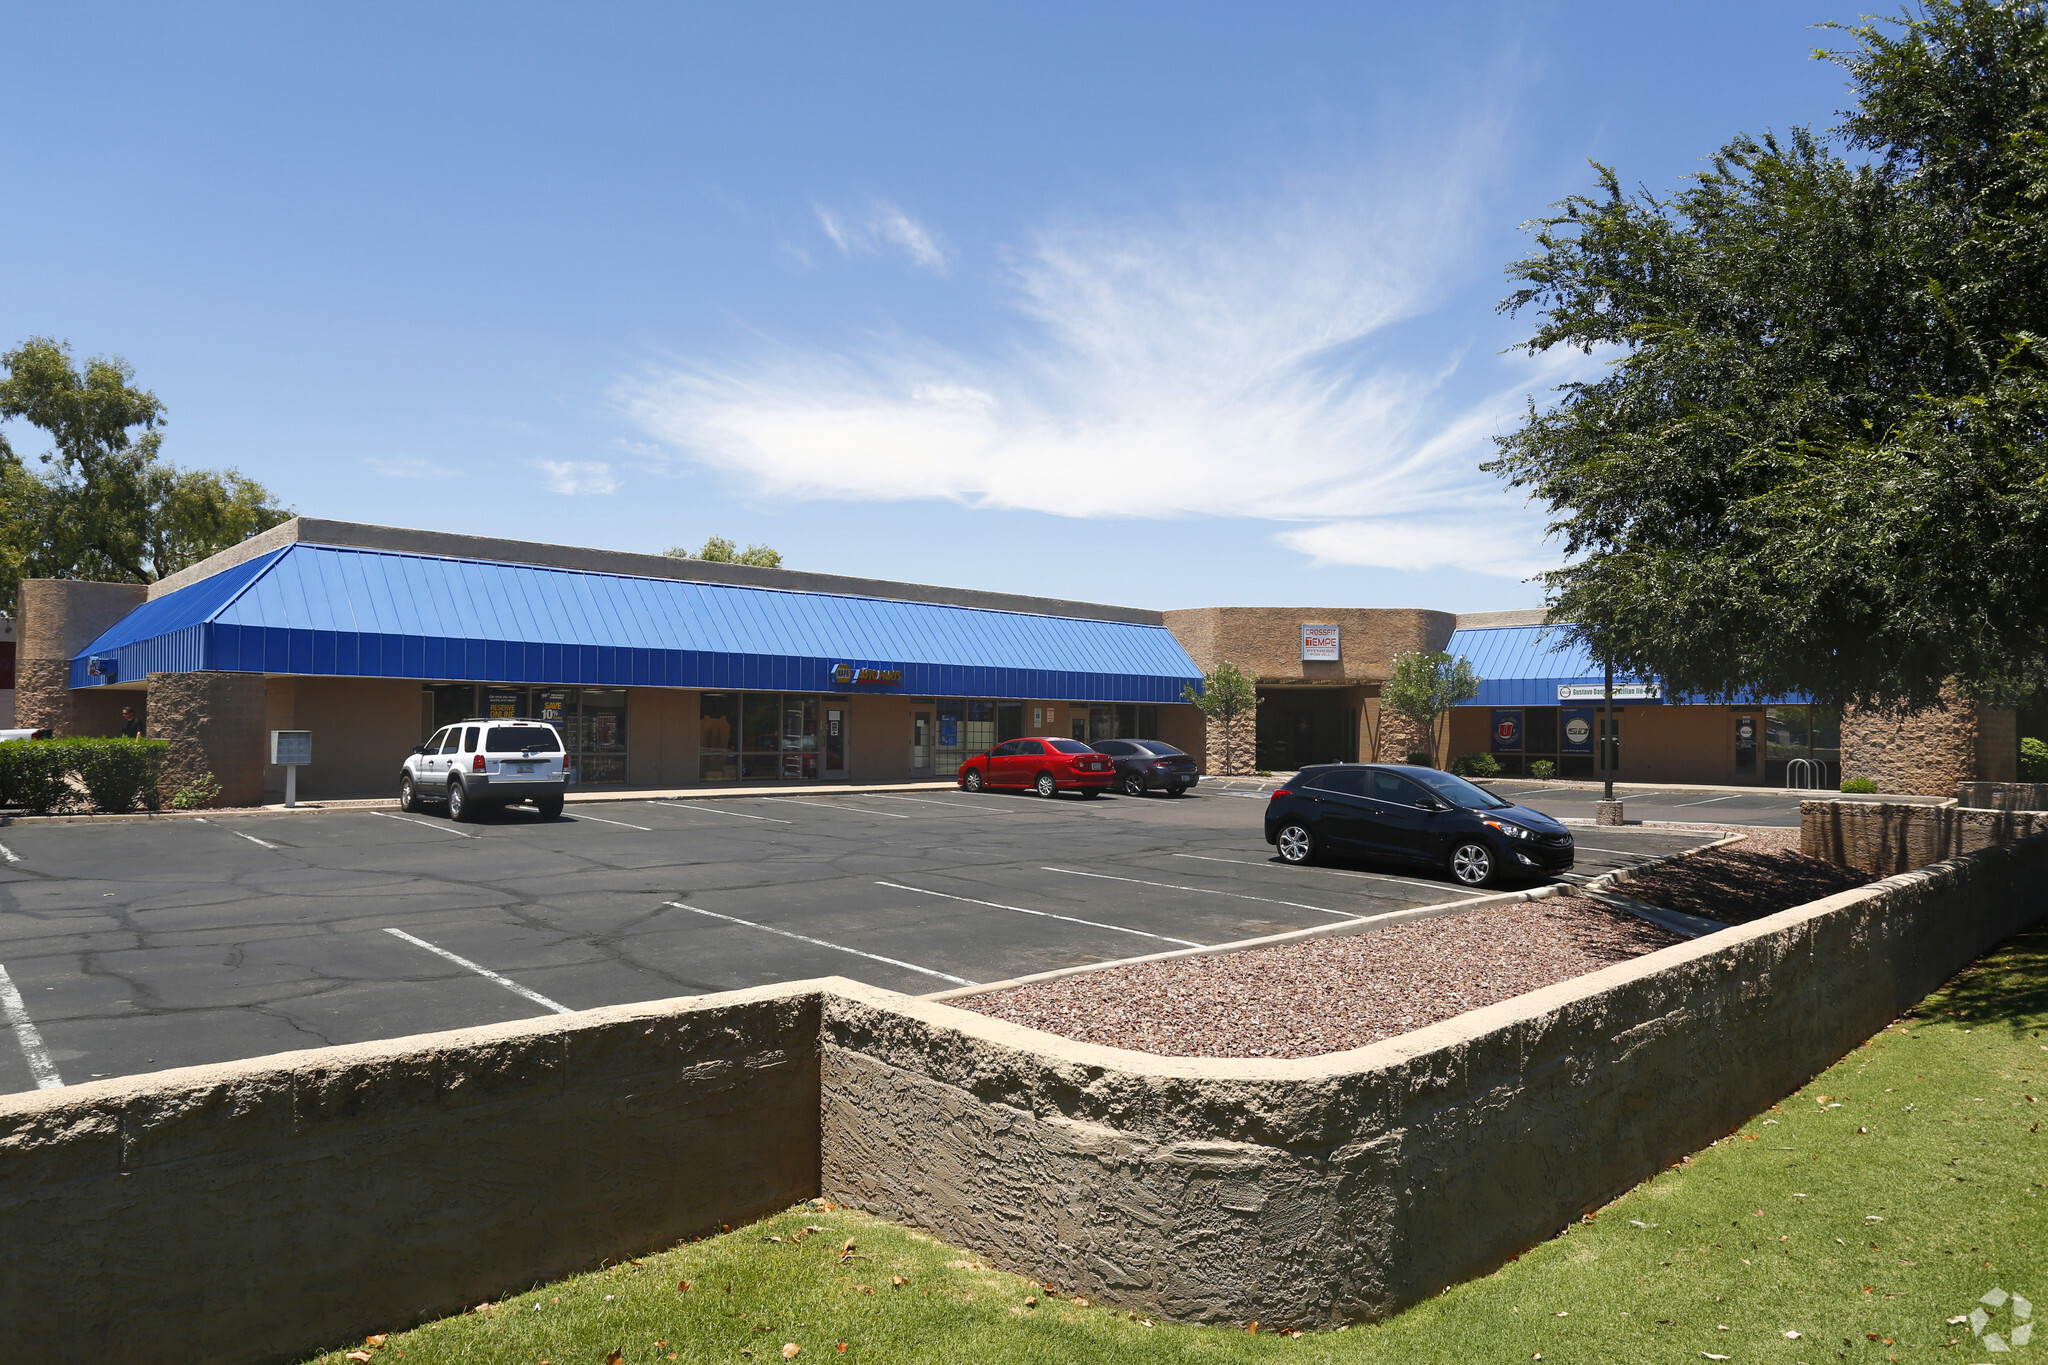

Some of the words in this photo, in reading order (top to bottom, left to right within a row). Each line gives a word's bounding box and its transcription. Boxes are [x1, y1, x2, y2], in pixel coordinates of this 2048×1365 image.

[1306, 636, 1336, 646] TEMPE
[838, 669, 850, 678] NAPA
[859, 669, 877, 680] AUTO
[879, 670, 902, 681] PARTS
[544, 702, 562, 710] SAVE
